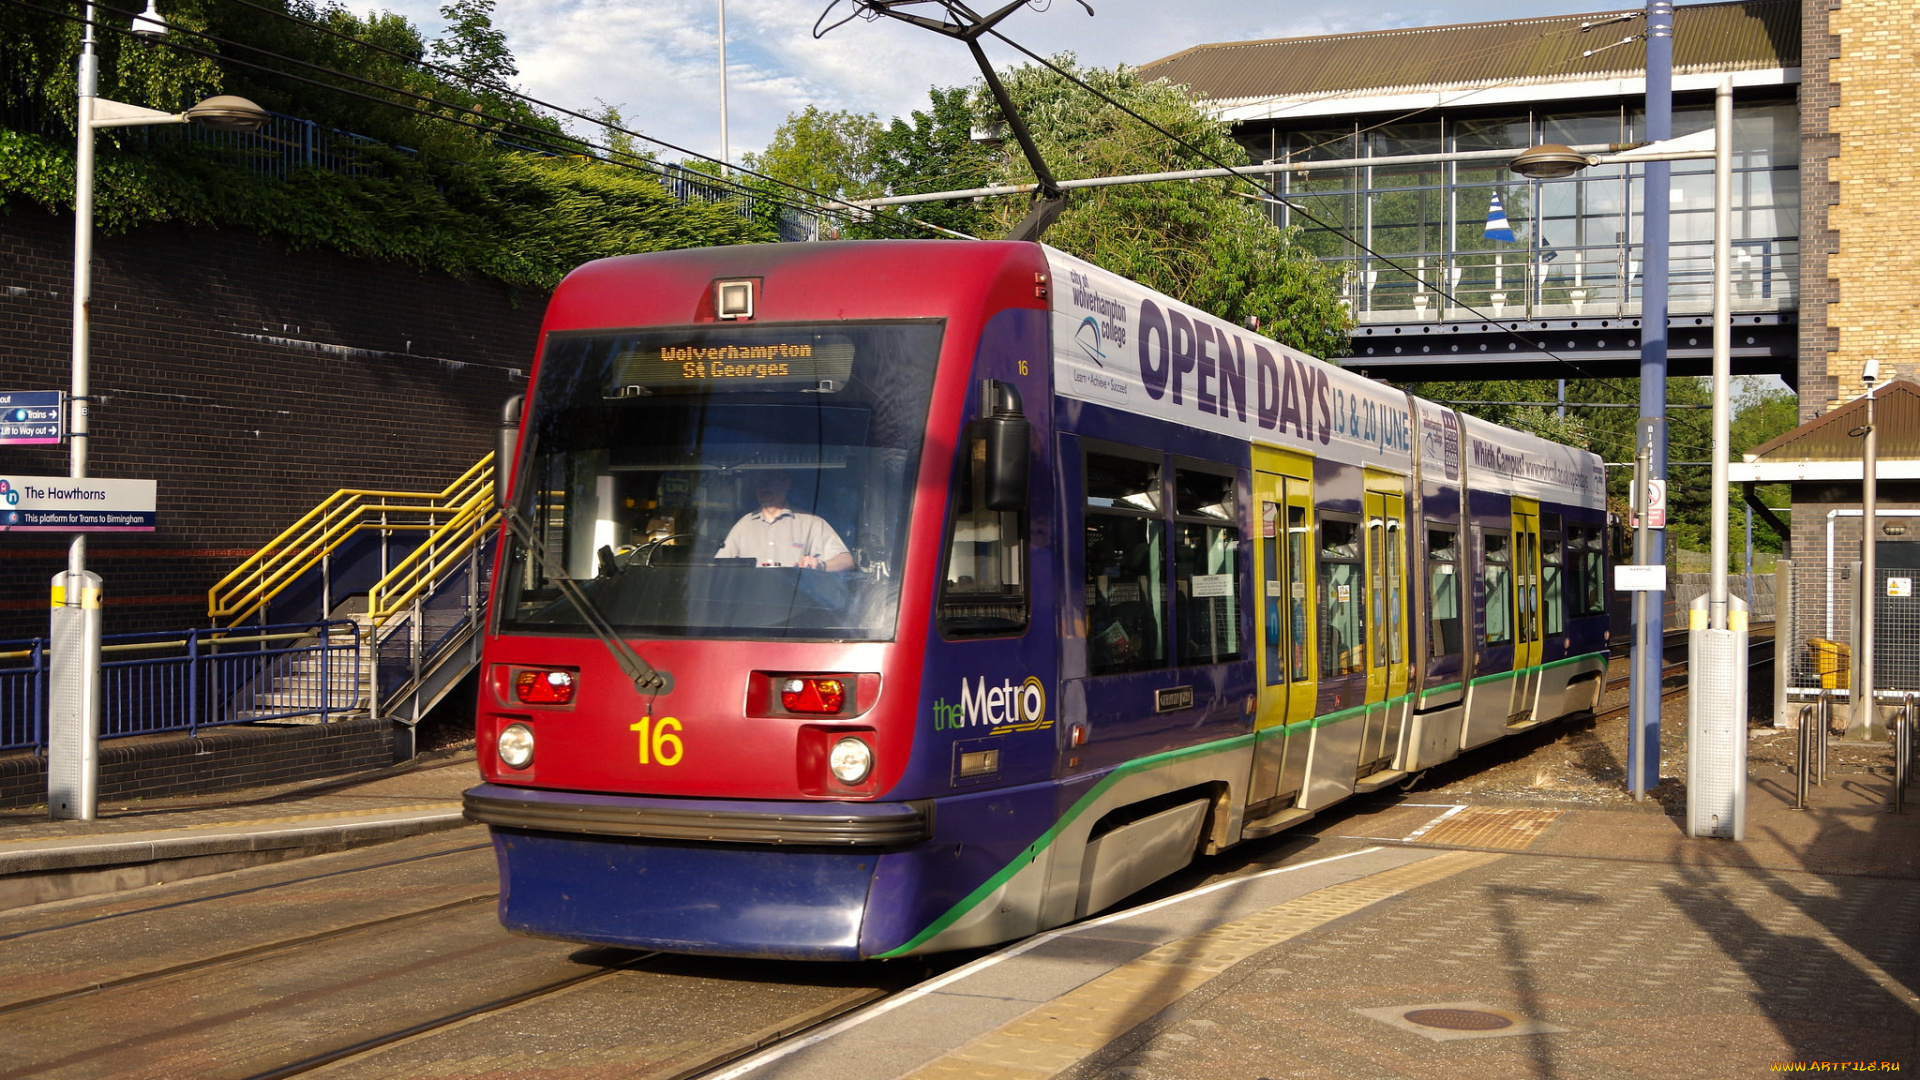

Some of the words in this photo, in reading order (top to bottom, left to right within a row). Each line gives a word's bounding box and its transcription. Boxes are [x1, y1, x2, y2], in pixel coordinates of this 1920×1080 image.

[1073, 286, 1126, 324] wolverhampton
[1102, 321, 1126, 348] college
[661, 344, 812, 361] Wolverhampton
[683, 361, 705, 378] St
[710, 361, 789, 378] Georges
[1017, 360, 1028, 376] 16
[1138, 298, 1247, 424] OPEN
[1254, 342, 1331, 446] DAYS
[1333, 387, 1345, 433] 13
[1350, 393, 1359, 438] &
[1363, 397, 1376, 442] 20
[1380, 403, 1409, 455] JUNE
[28, 410, 47, 418] Trains
[12, 427, 18, 435] to
[20, 426, 34, 437] Way
[35, 426, 47, 434] out
[1473, 440, 1495, 469] Which
[25, 486, 45, 499] The
[48, 487, 106, 500] Hawthorns
[25, 513, 38, 521] This
[39, 514, 67, 525] platform
[69, 513, 78, 522] for
[79, 514, 98, 523] Trams
[99, 514, 106, 523] to
[107, 515, 144, 525] Birmingham
[933, 697, 962, 731] the
[960, 675, 1043, 728] Metro
[629, 716, 683, 766] 16
